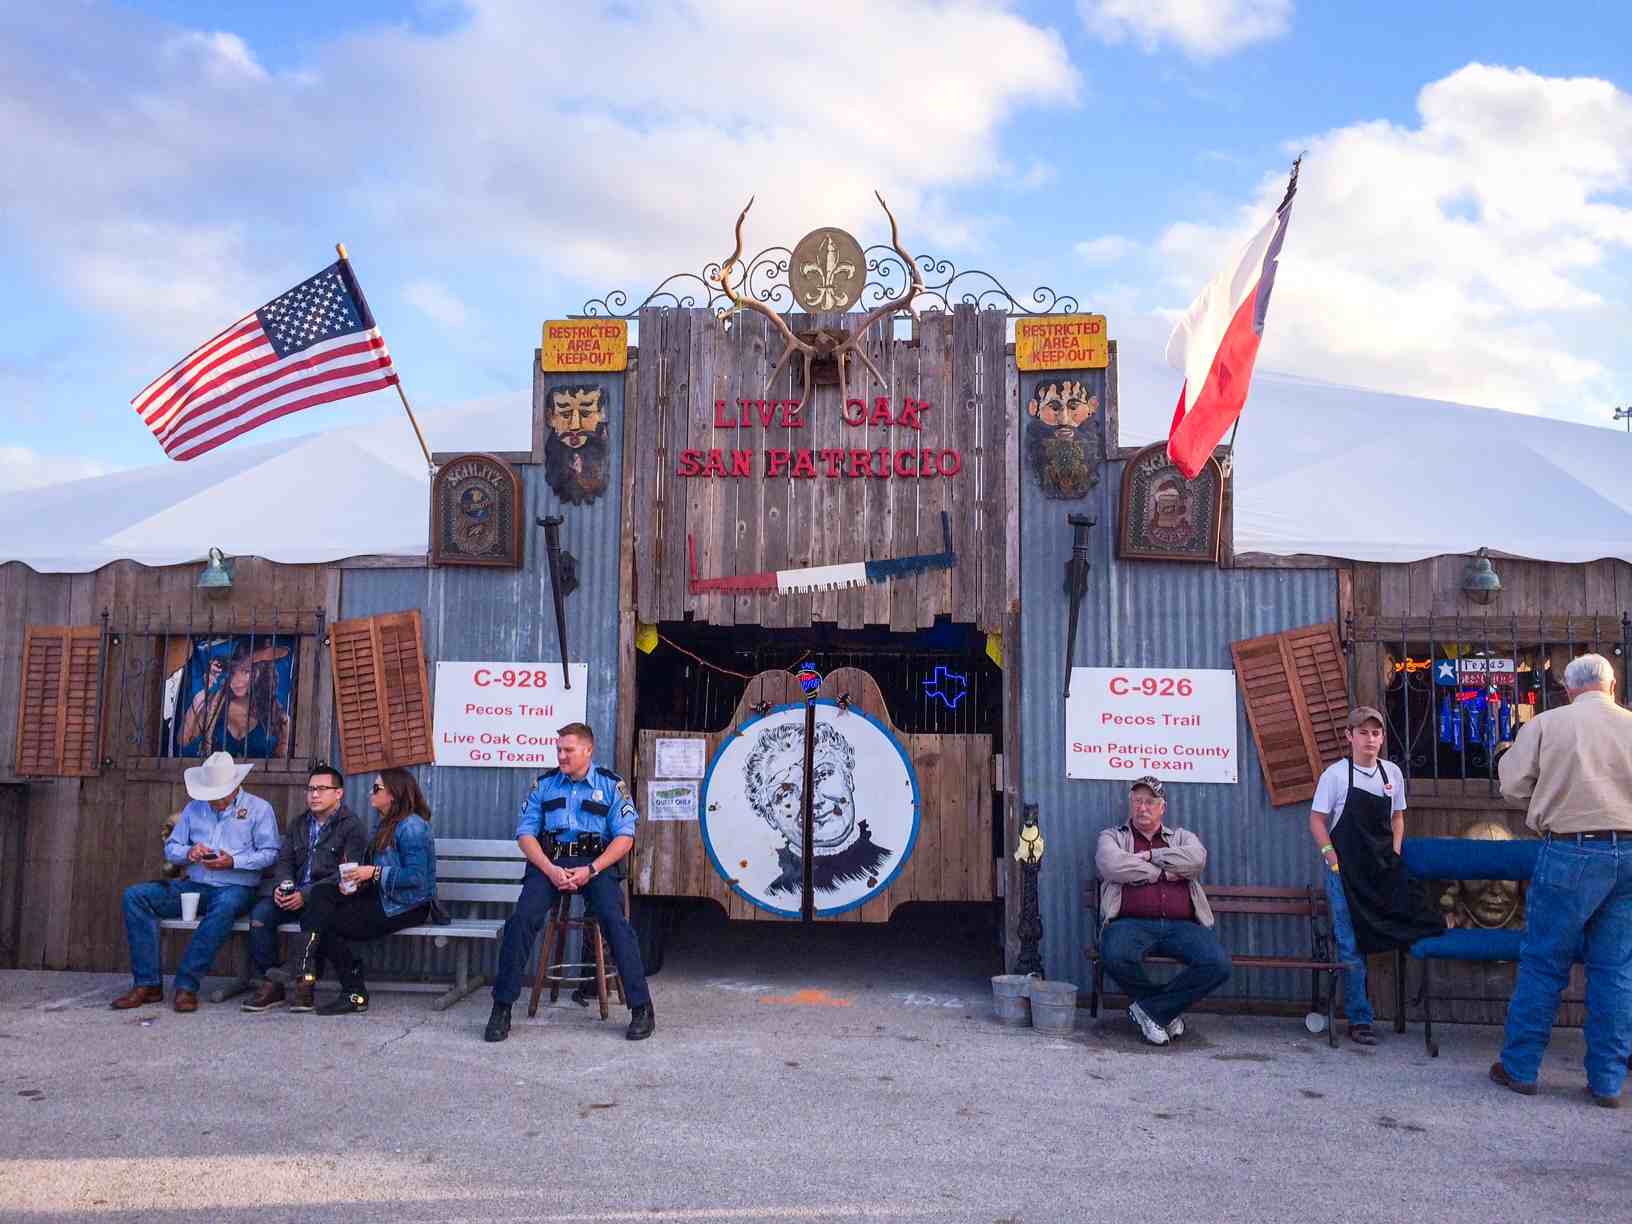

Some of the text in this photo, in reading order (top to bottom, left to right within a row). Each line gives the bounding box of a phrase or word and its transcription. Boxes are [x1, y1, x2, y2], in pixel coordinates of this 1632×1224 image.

[549, 326, 621, 338] RESTRICTED
[1023, 322, 1100, 336] RESTRICTED
[567, 339, 601, 351] AREA
[1043, 336, 1080, 349] AREA
[557, 351, 615, 365] KEEP OUT
[1032, 349, 1095, 363] KEEP OUT
[714, 396, 931, 431] LIVE OAK
[677, 448, 961, 480] SAN PATRICIO
[473, 668, 548, 688] C-928
[1109, 676, 1193, 697] C-926
[465, 703, 553, 717] Pecos Trail
[1101, 712, 1200, 727] Pecos Trail
[443, 732, 560, 746] Live Oak Coun
[470, 749, 545, 763] Go Texan
[1072, 742, 1231, 760] San Patricio County
[1108, 756, 1194, 771] Go Texan
